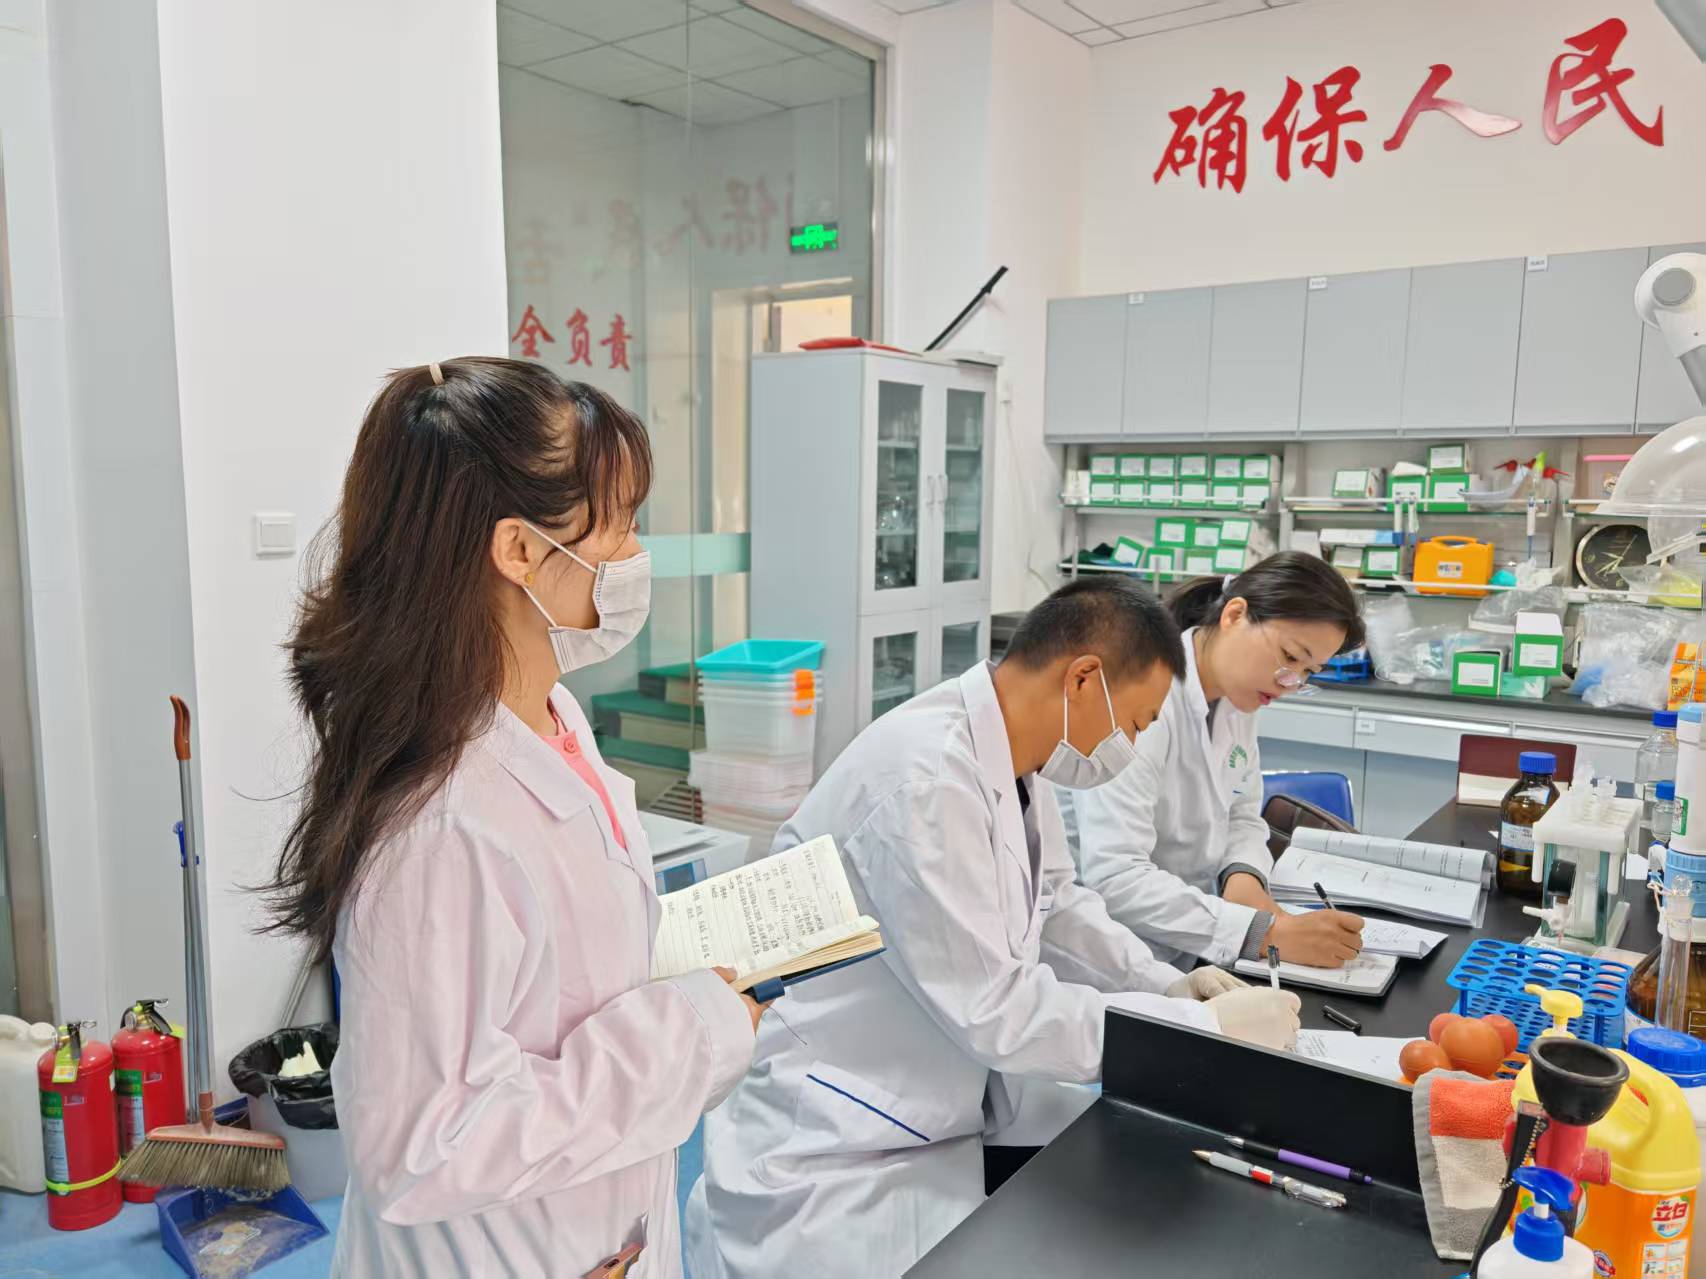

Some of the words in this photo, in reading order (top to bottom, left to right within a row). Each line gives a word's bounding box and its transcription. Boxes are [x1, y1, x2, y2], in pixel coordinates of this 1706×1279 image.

[1153, 18, 1664, 194] 确保人民
[512, 304, 632, 373] 全负责
[1652, 1203, 1688, 1221] 立白
